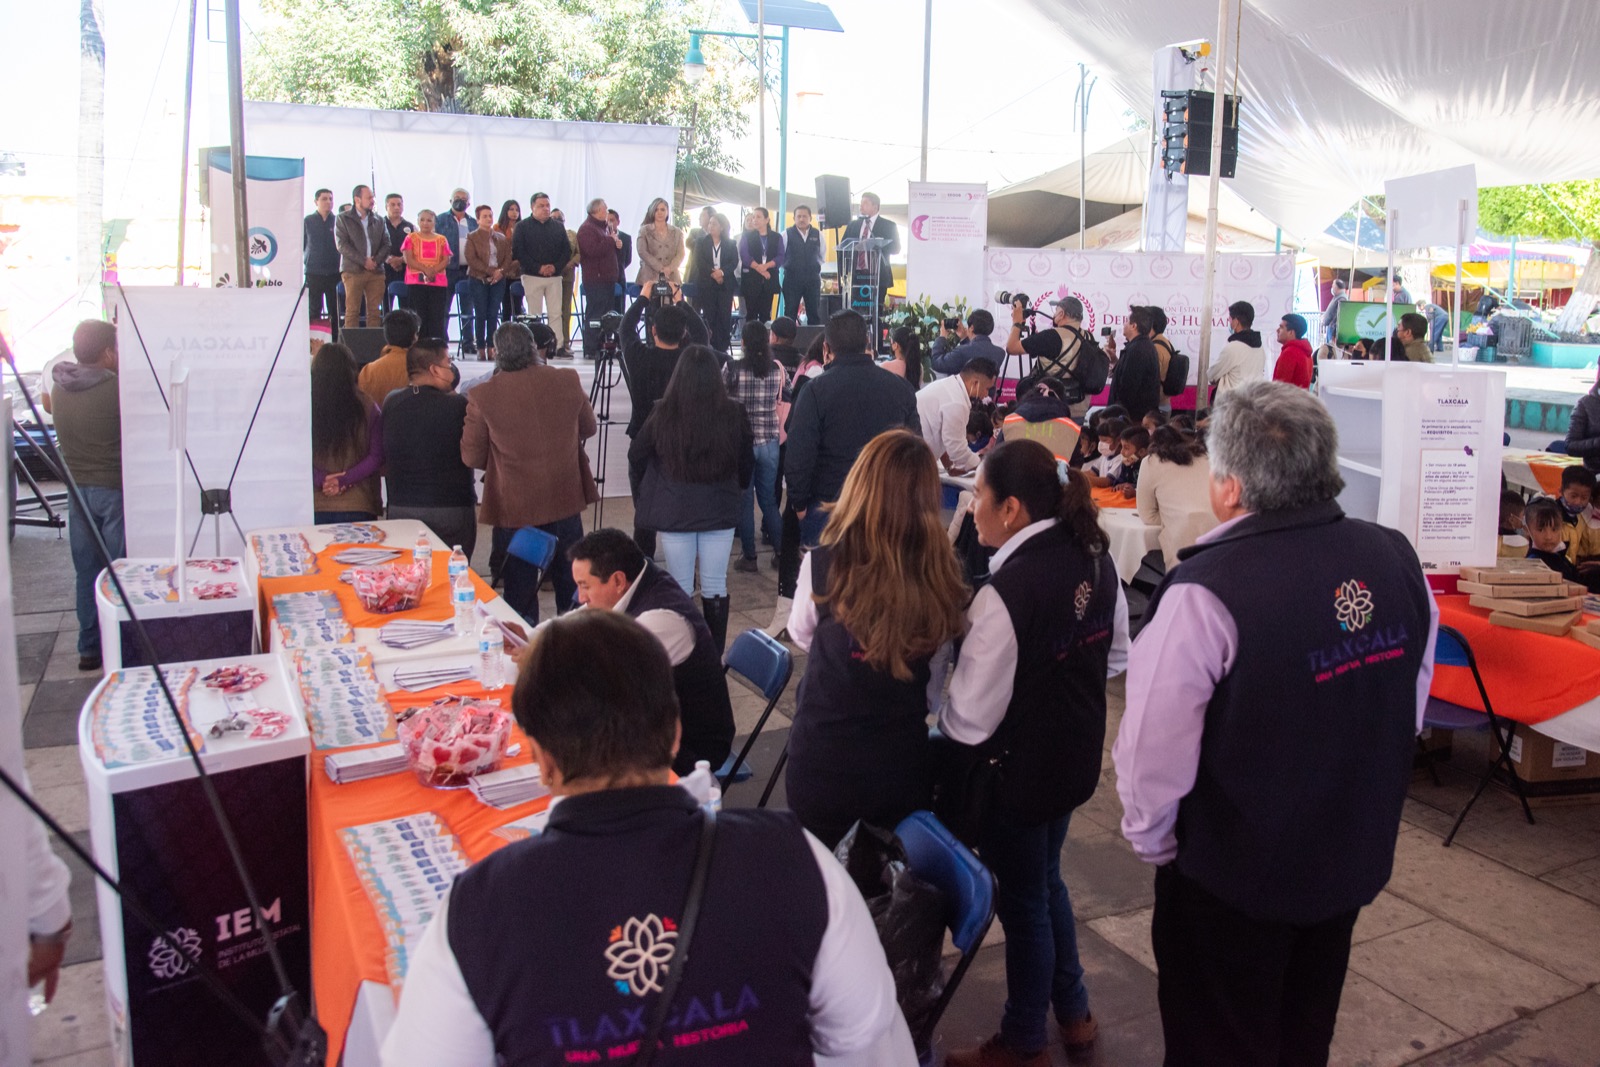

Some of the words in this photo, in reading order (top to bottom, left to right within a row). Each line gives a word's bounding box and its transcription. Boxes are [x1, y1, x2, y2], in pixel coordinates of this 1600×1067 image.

[1307, 622, 1410, 672] TLAXCALA
[215, 896, 282, 943] IEM
[673, 1019, 749, 1048] HISTORIA
